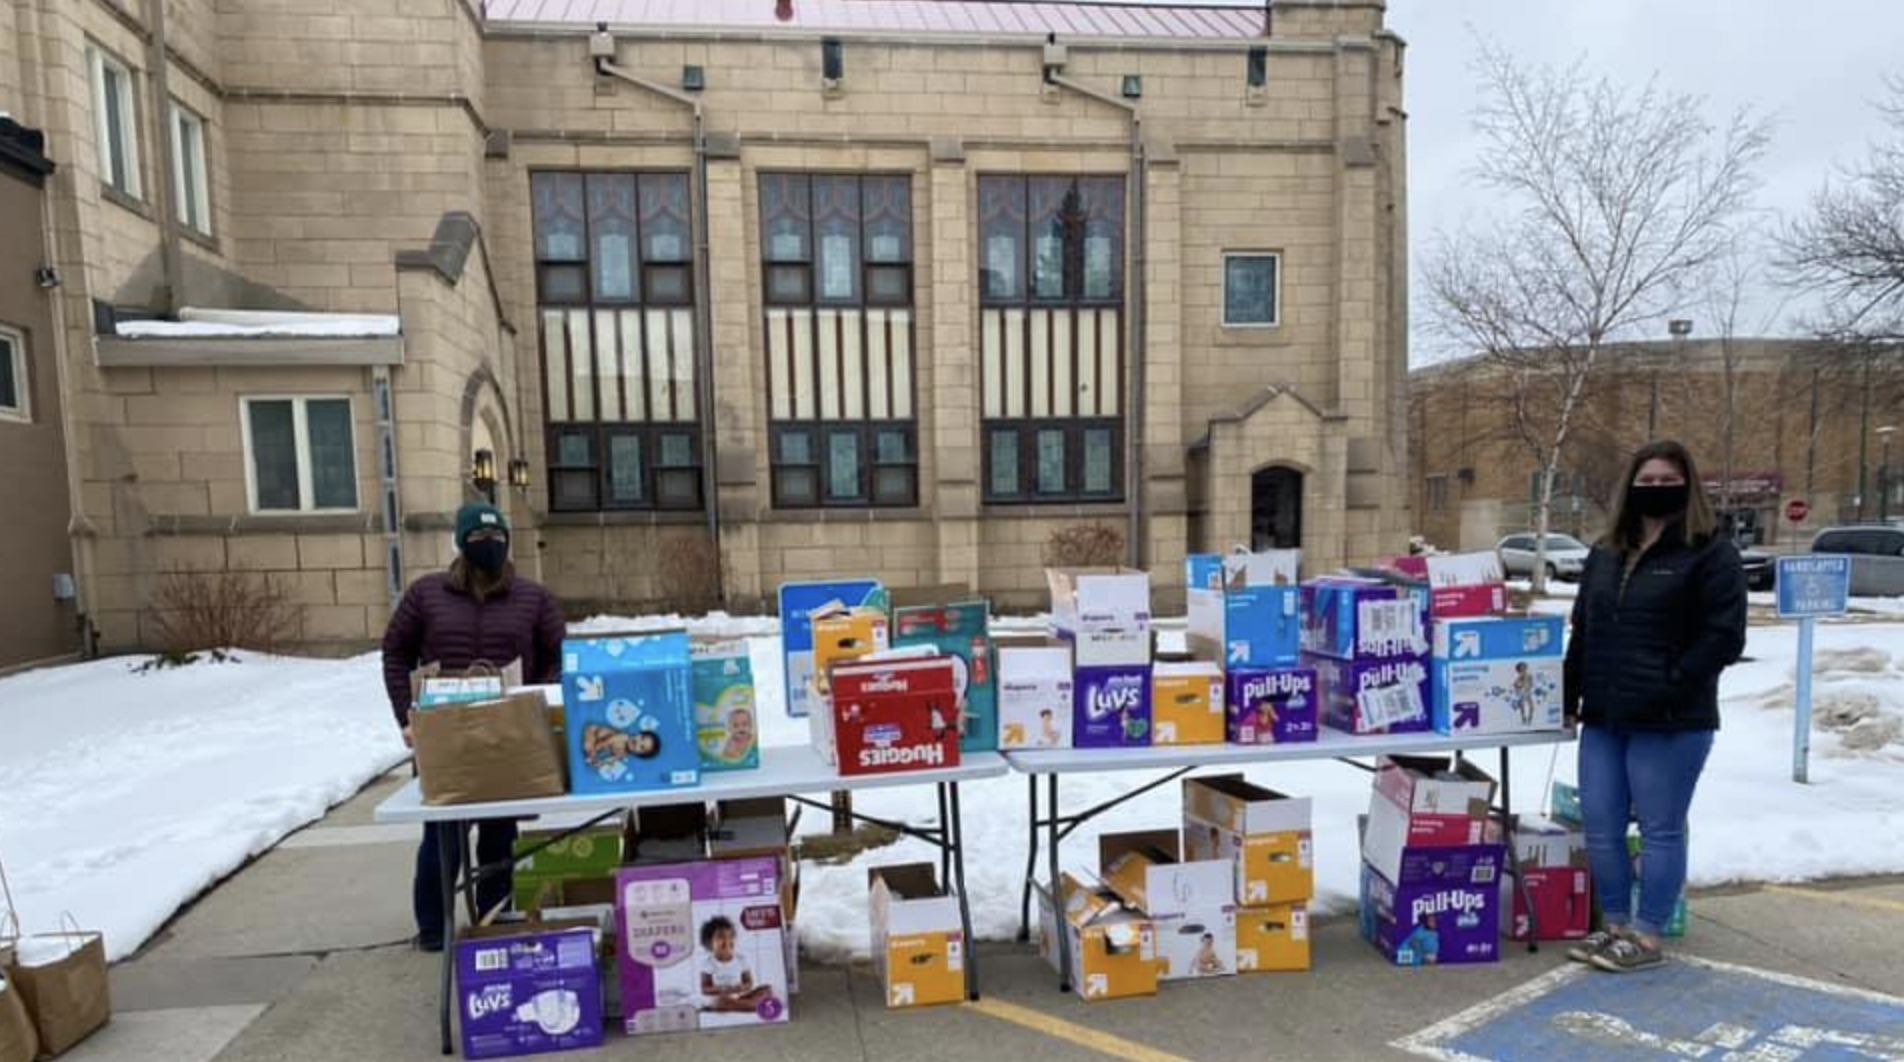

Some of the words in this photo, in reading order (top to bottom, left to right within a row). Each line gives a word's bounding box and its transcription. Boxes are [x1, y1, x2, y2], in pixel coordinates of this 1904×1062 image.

[1243, 674, 1311, 708] Pull-Ups
[858, 742, 944, 767] HUGGIES
[1412, 889, 1485, 926] Pull-Ups
